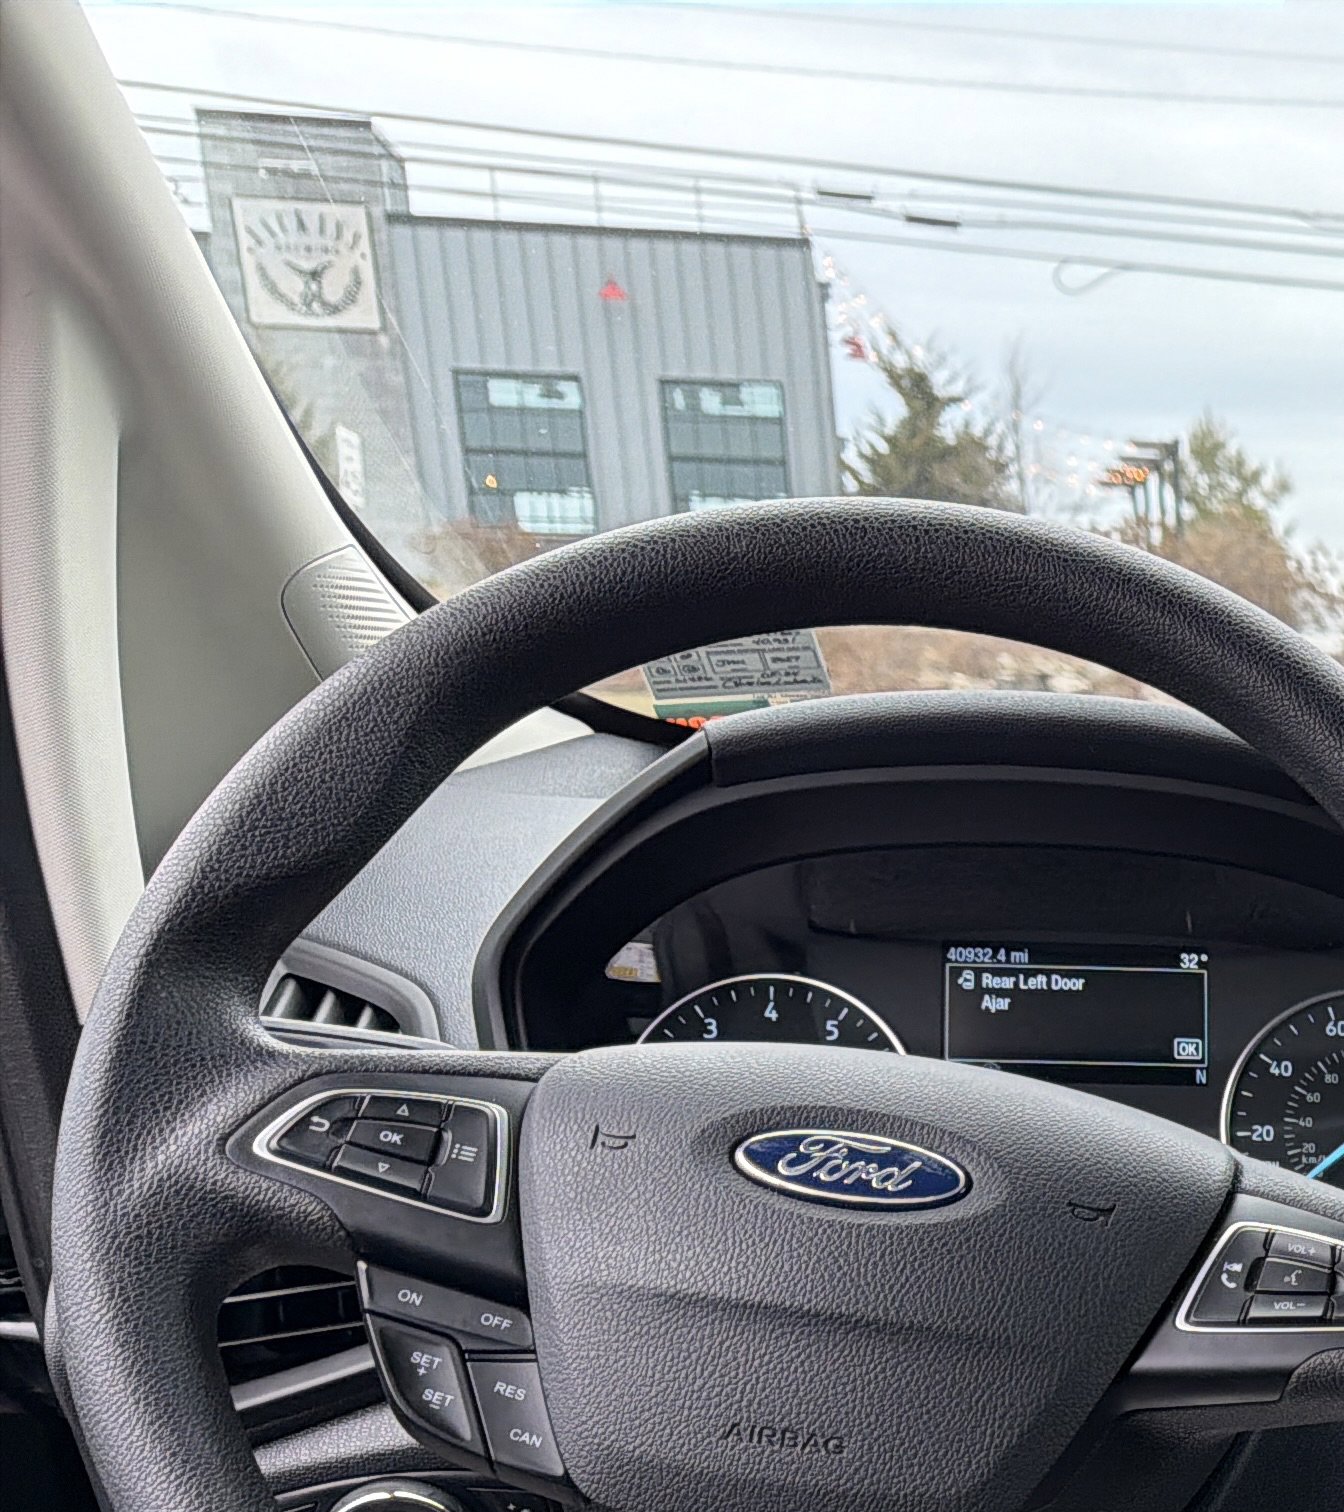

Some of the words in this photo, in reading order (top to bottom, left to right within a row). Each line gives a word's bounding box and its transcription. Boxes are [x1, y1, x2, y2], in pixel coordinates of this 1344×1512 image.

[946, 947, 1006, 963] 40932.4
[1010, 949, 1028, 963] mi
[981, 974, 1016, 989] Rear
[1019, 974, 1048, 990] Left
[1051, 975, 1085, 991] Door
[764, 1002, 778, 1022] 4
[981, 995, 1011, 1013] Ajar
[703, 1018, 718, 1039] 3
[825, 1020, 839, 1041] 5
[1179, 1043, 1197, 1056] OK
[1195, 1070, 1207, 1084] N
[1269, 1061, 1292, 1077] 40
[1324, 1073, 1339, 1084] 80
[1306, 1092, 1321, 1103] 60
[1299, 1117, 1313, 1128] 40
[380, 1130, 404, 1146] OK
[1251, 1125, 1274, 1142] 20
[1302, 1143, 1316, 1154] 20
[777, 1134, 916, 1194] Ford
[398, 1289, 423, 1306] ON
[481, 1313, 513, 1332] OFF
[410, 1351, 442, 1371] SET
[422, 1388, 455, 1409] SET
[494, 1382, 526, 1401] RES
[510, 1428, 543, 1449] CAN
[722, 1422, 847, 1455] AIRBAG
